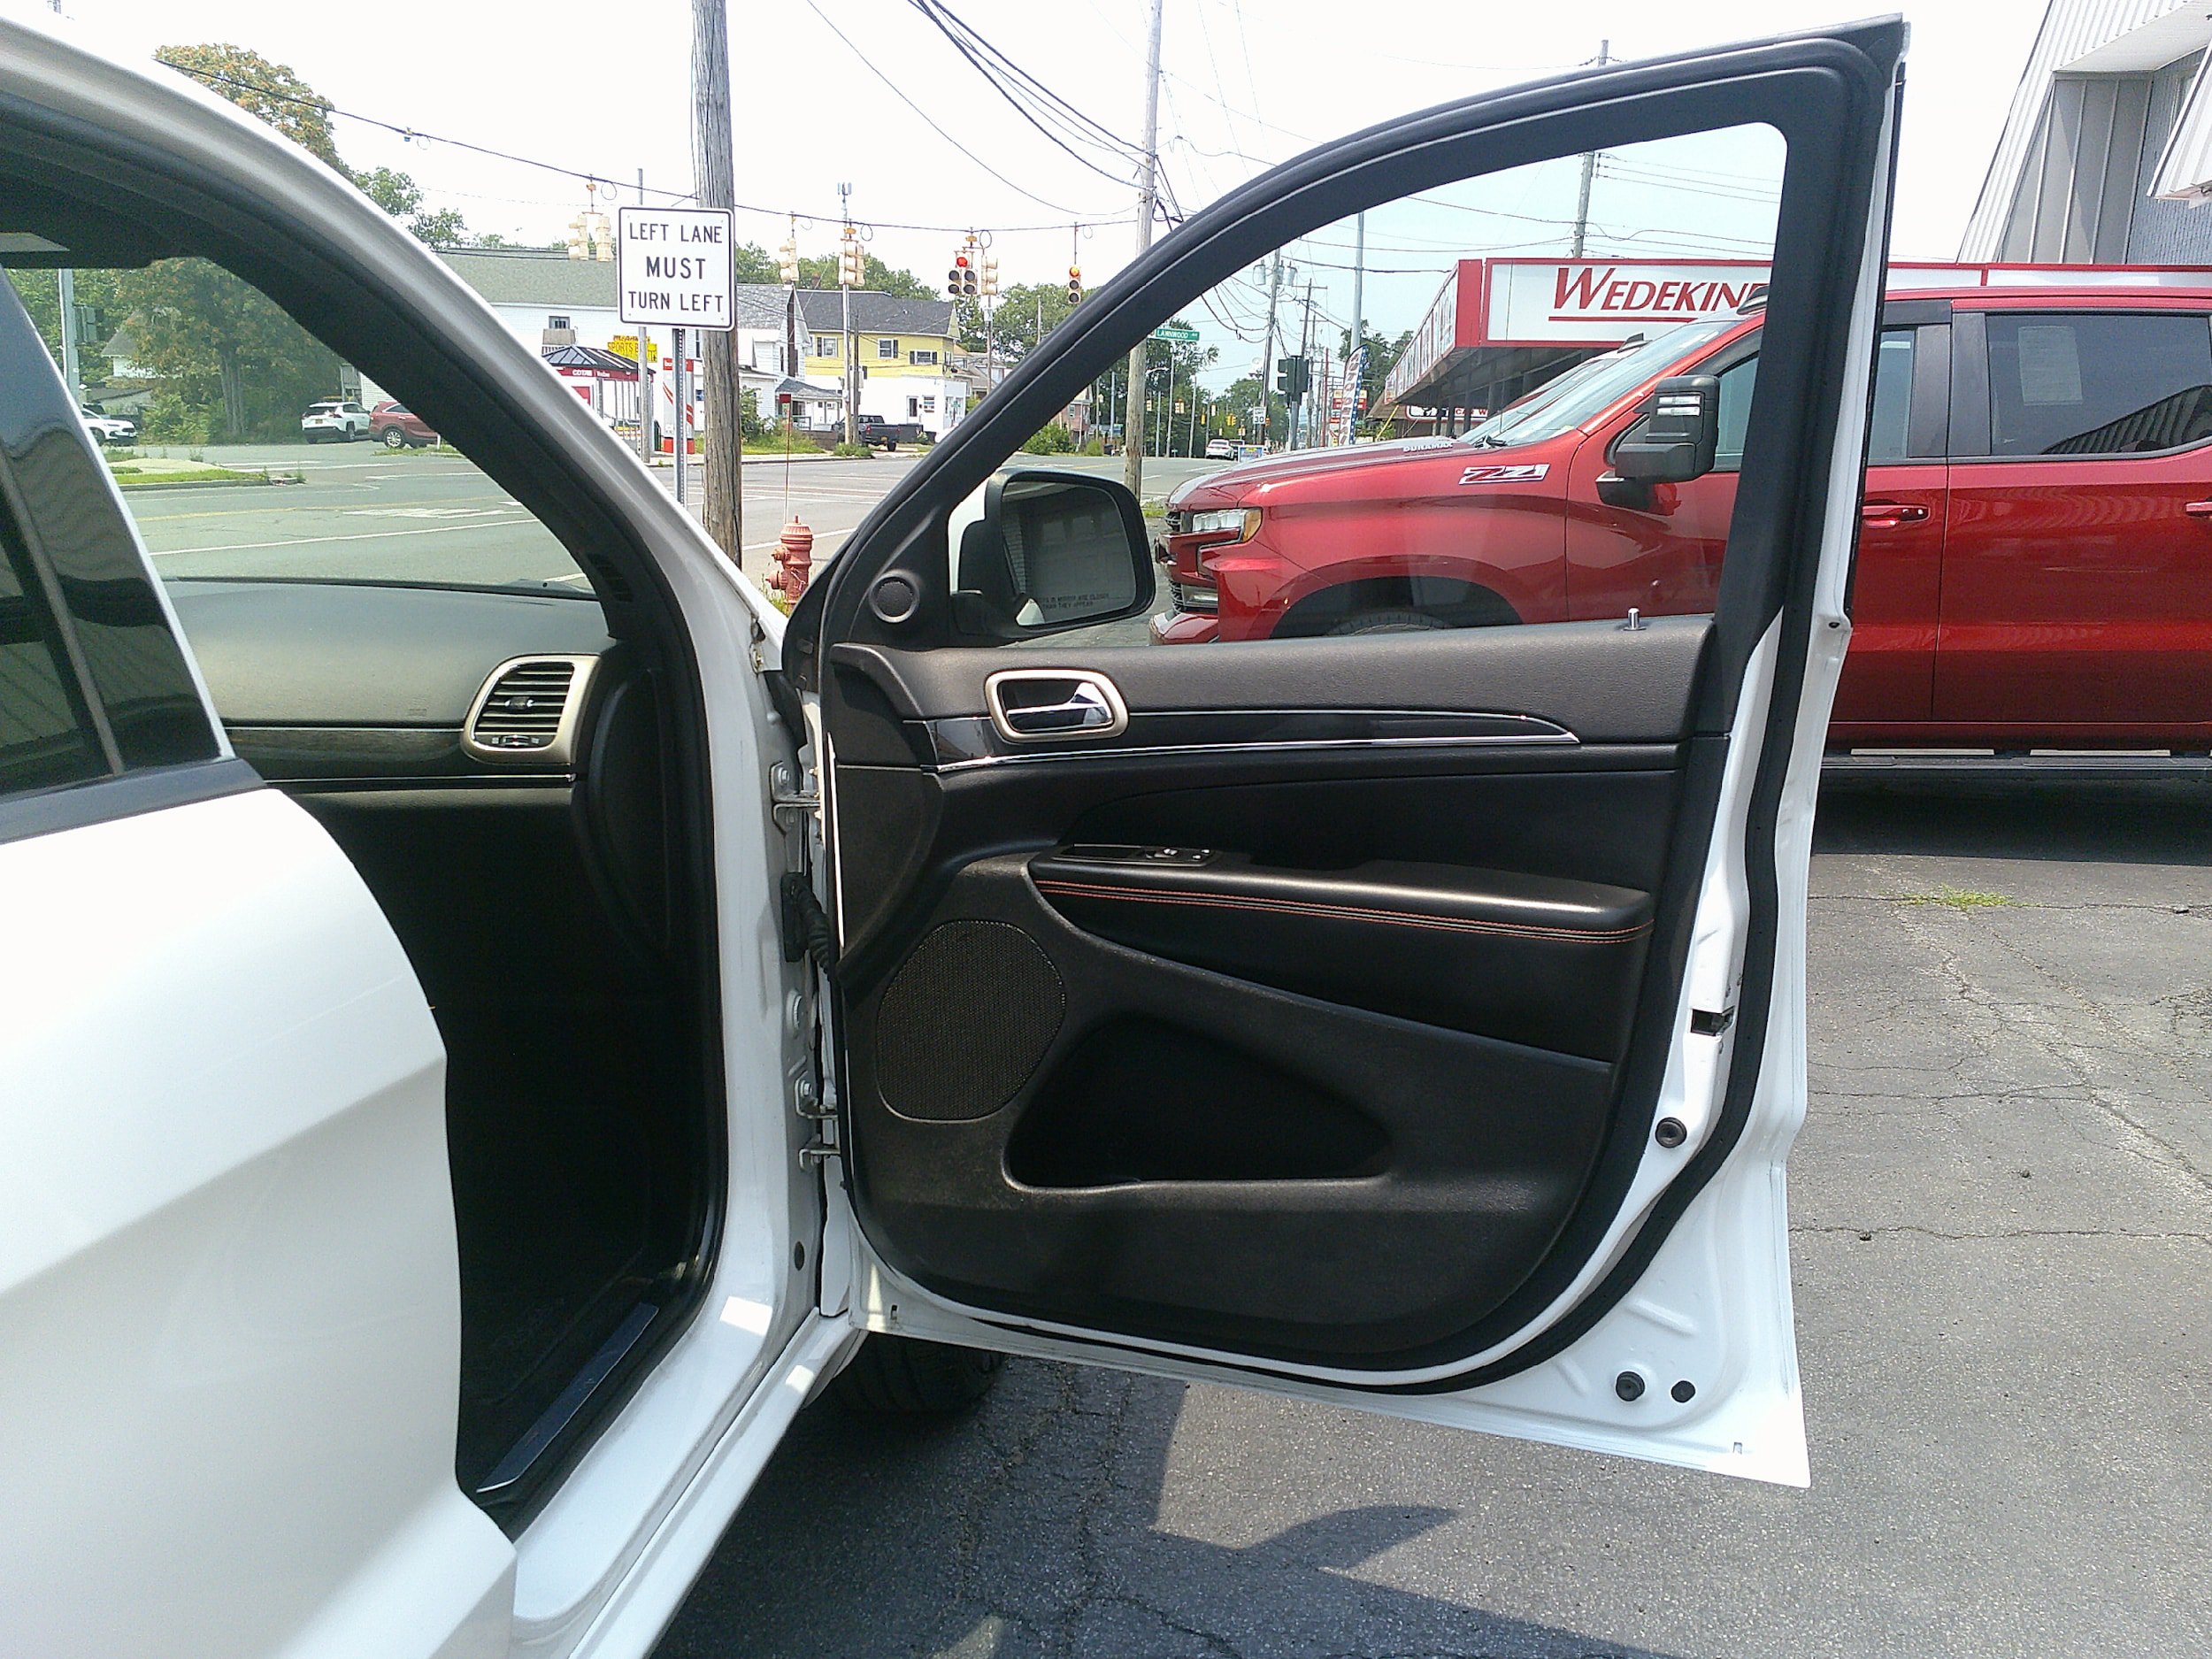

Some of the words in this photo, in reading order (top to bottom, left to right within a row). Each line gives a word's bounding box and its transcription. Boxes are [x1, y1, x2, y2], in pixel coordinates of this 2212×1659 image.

[629, 222, 670, 242] LEFT
[680, 225, 723, 244] LANE
[646, 256, 707, 280] MUST
[1554, 266, 1769, 311] WEDEKIN
[627, 290, 671, 311] TURN
[680, 293, 724, 313] LEFT
